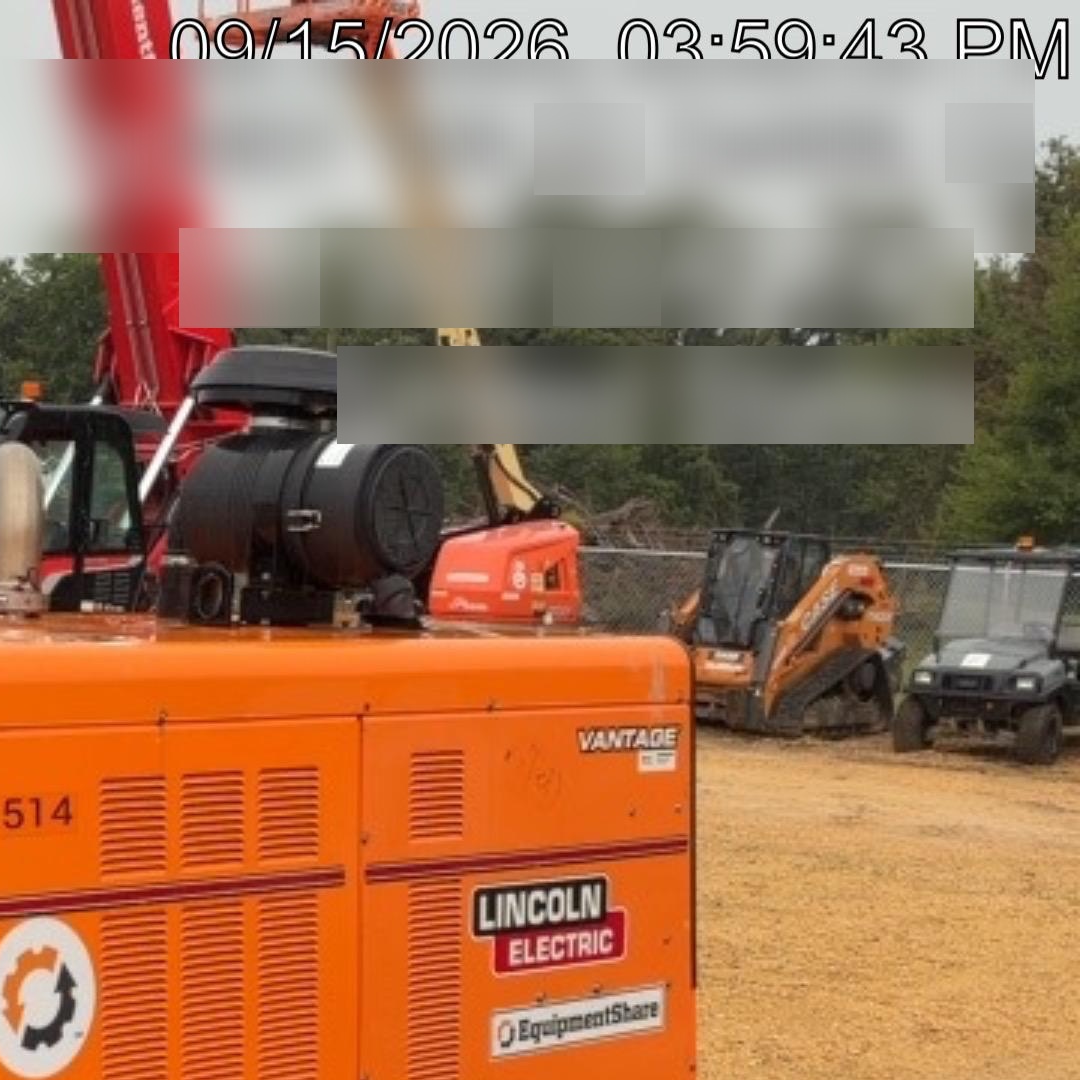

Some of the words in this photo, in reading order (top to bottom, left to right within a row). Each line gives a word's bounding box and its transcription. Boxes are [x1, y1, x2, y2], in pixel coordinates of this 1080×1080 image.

[576, 726, 681, 752] VANTAGE
[478, 884, 603, 932] LINCOLN
[508, 928, 614, 968] ELECTRIC
[517, 1001, 661, 1043] EquipmentShare
